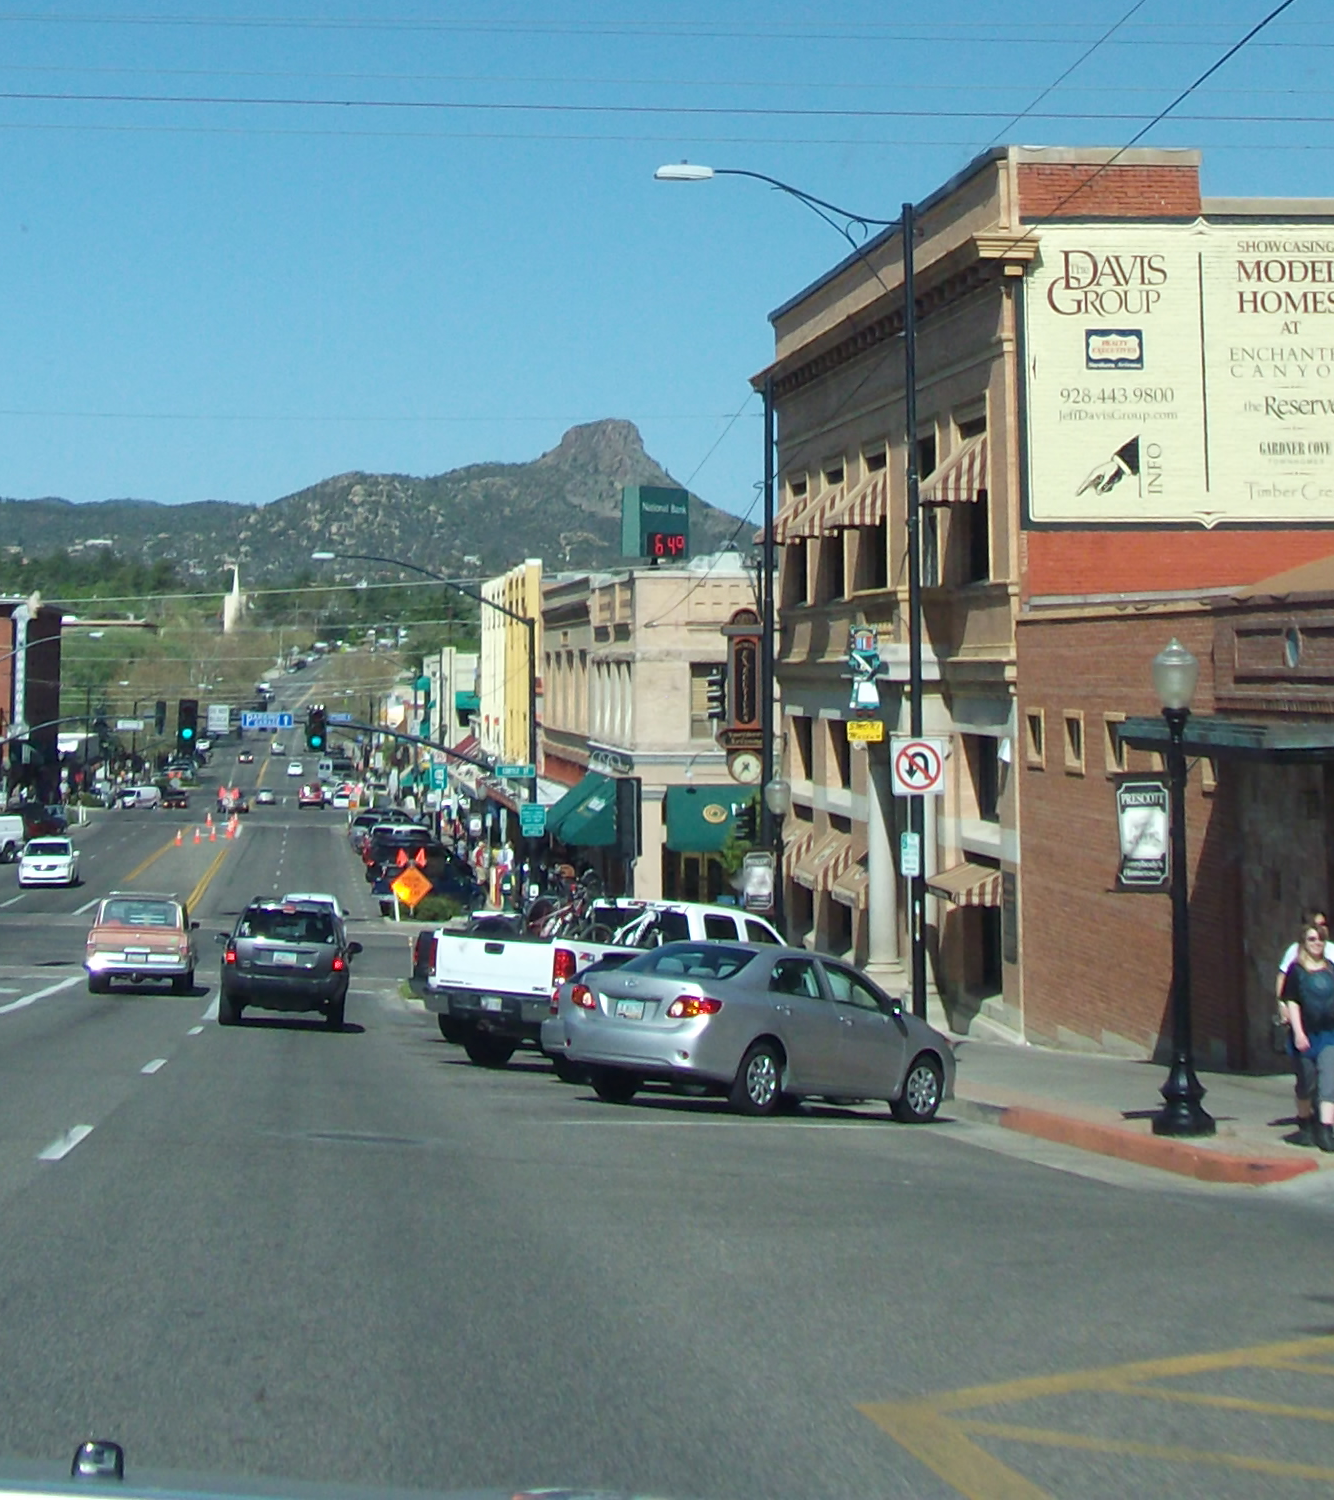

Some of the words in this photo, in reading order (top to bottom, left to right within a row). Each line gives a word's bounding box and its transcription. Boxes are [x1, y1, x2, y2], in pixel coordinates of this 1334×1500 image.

[1236, 240, 1334, 253] SHOWCASING
[1059, 250, 1168, 290] DAVIS
[1047, 276, 1161, 317] GROUP
[1280, 320, 1302, 335] AT
[1059, 387, 1175, 405] 928.443.9800
[1244, 400, 1262, 413] the
[1058, 409, 1178, 424] JeffDavisGroup.com
[1259, 441, 1305, 456] GARDNER
[1308, 441, 1332, 456] COVE
[1146, 443, 1163, 495] INFO
[1244, 480, 1296, 500] Timber
[1121, 791, 1165, 805] PRESCOTT
